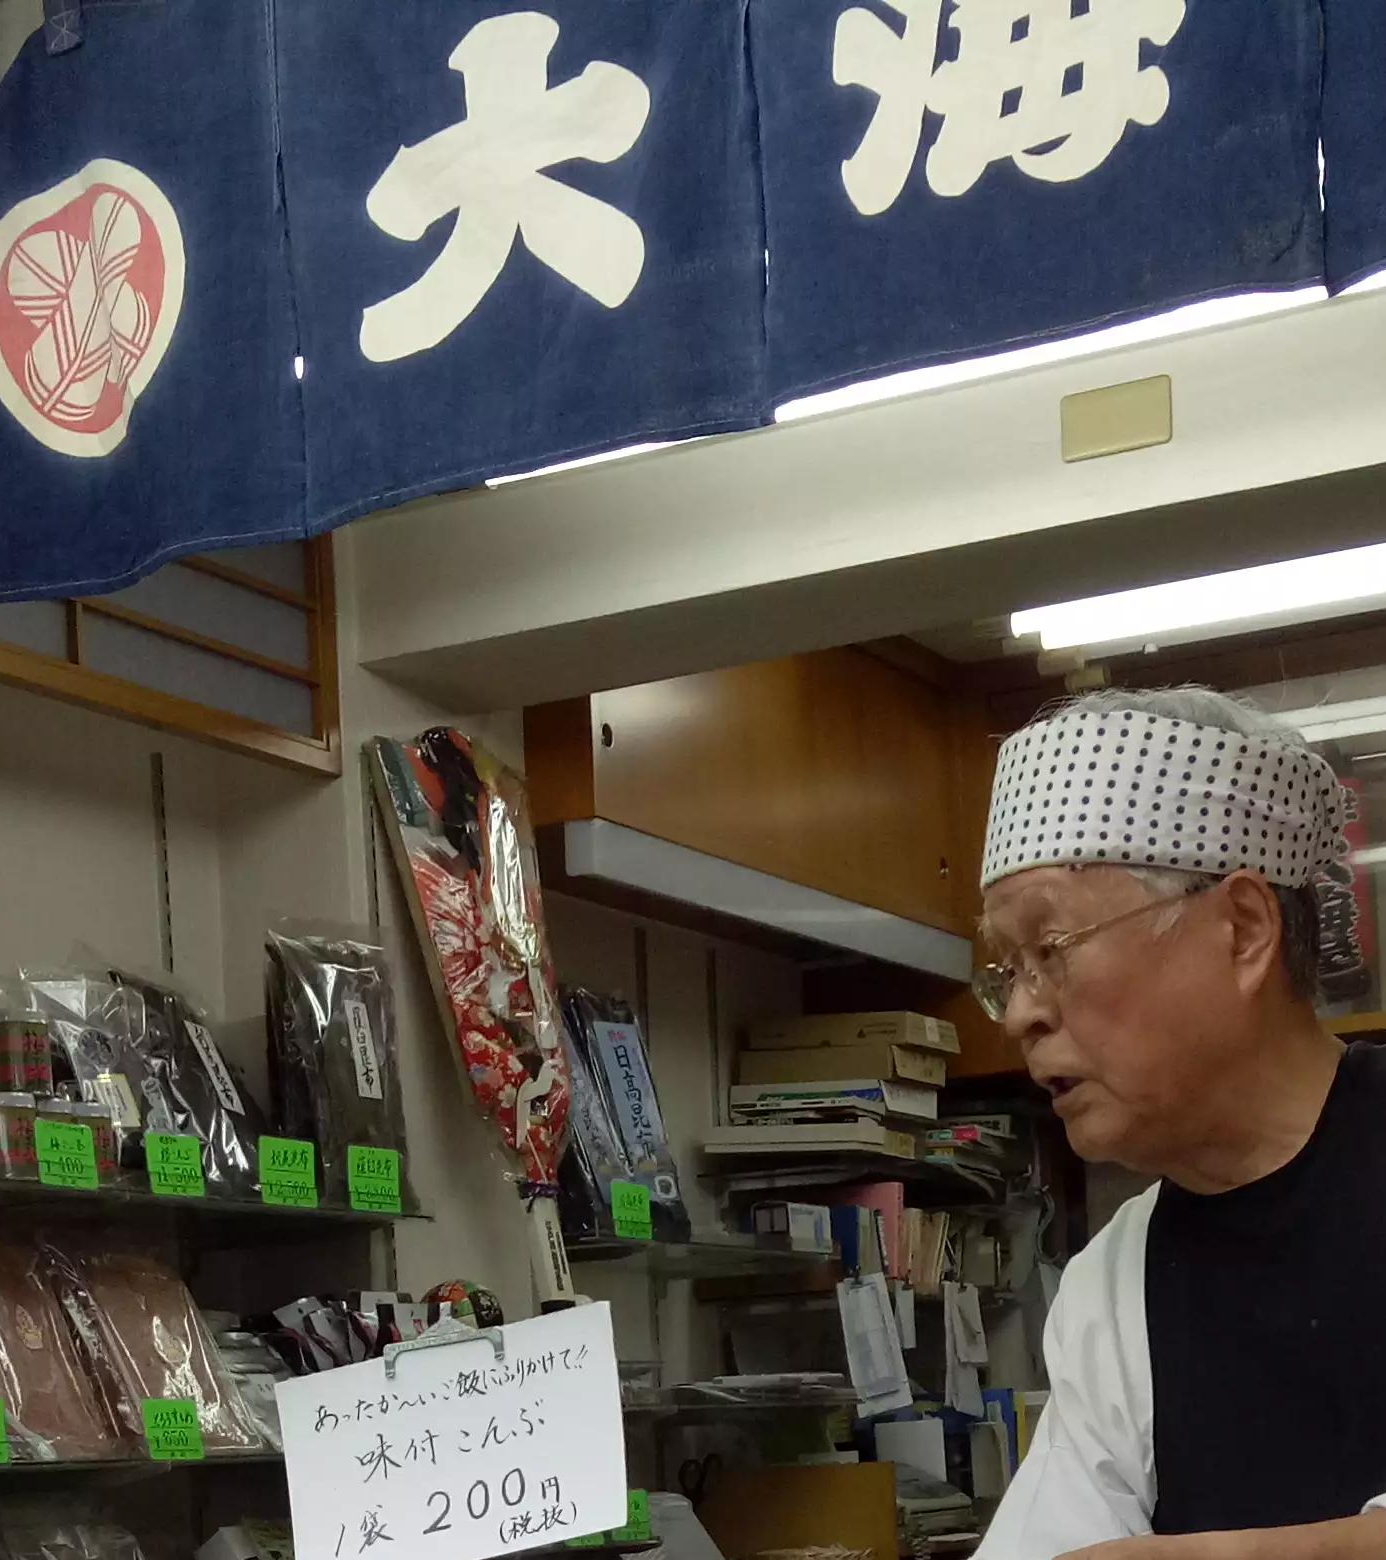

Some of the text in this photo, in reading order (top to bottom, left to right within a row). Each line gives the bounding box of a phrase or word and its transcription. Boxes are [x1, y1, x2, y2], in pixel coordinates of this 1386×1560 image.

[354, 1397, 547, 1485] 味付こんぶ
